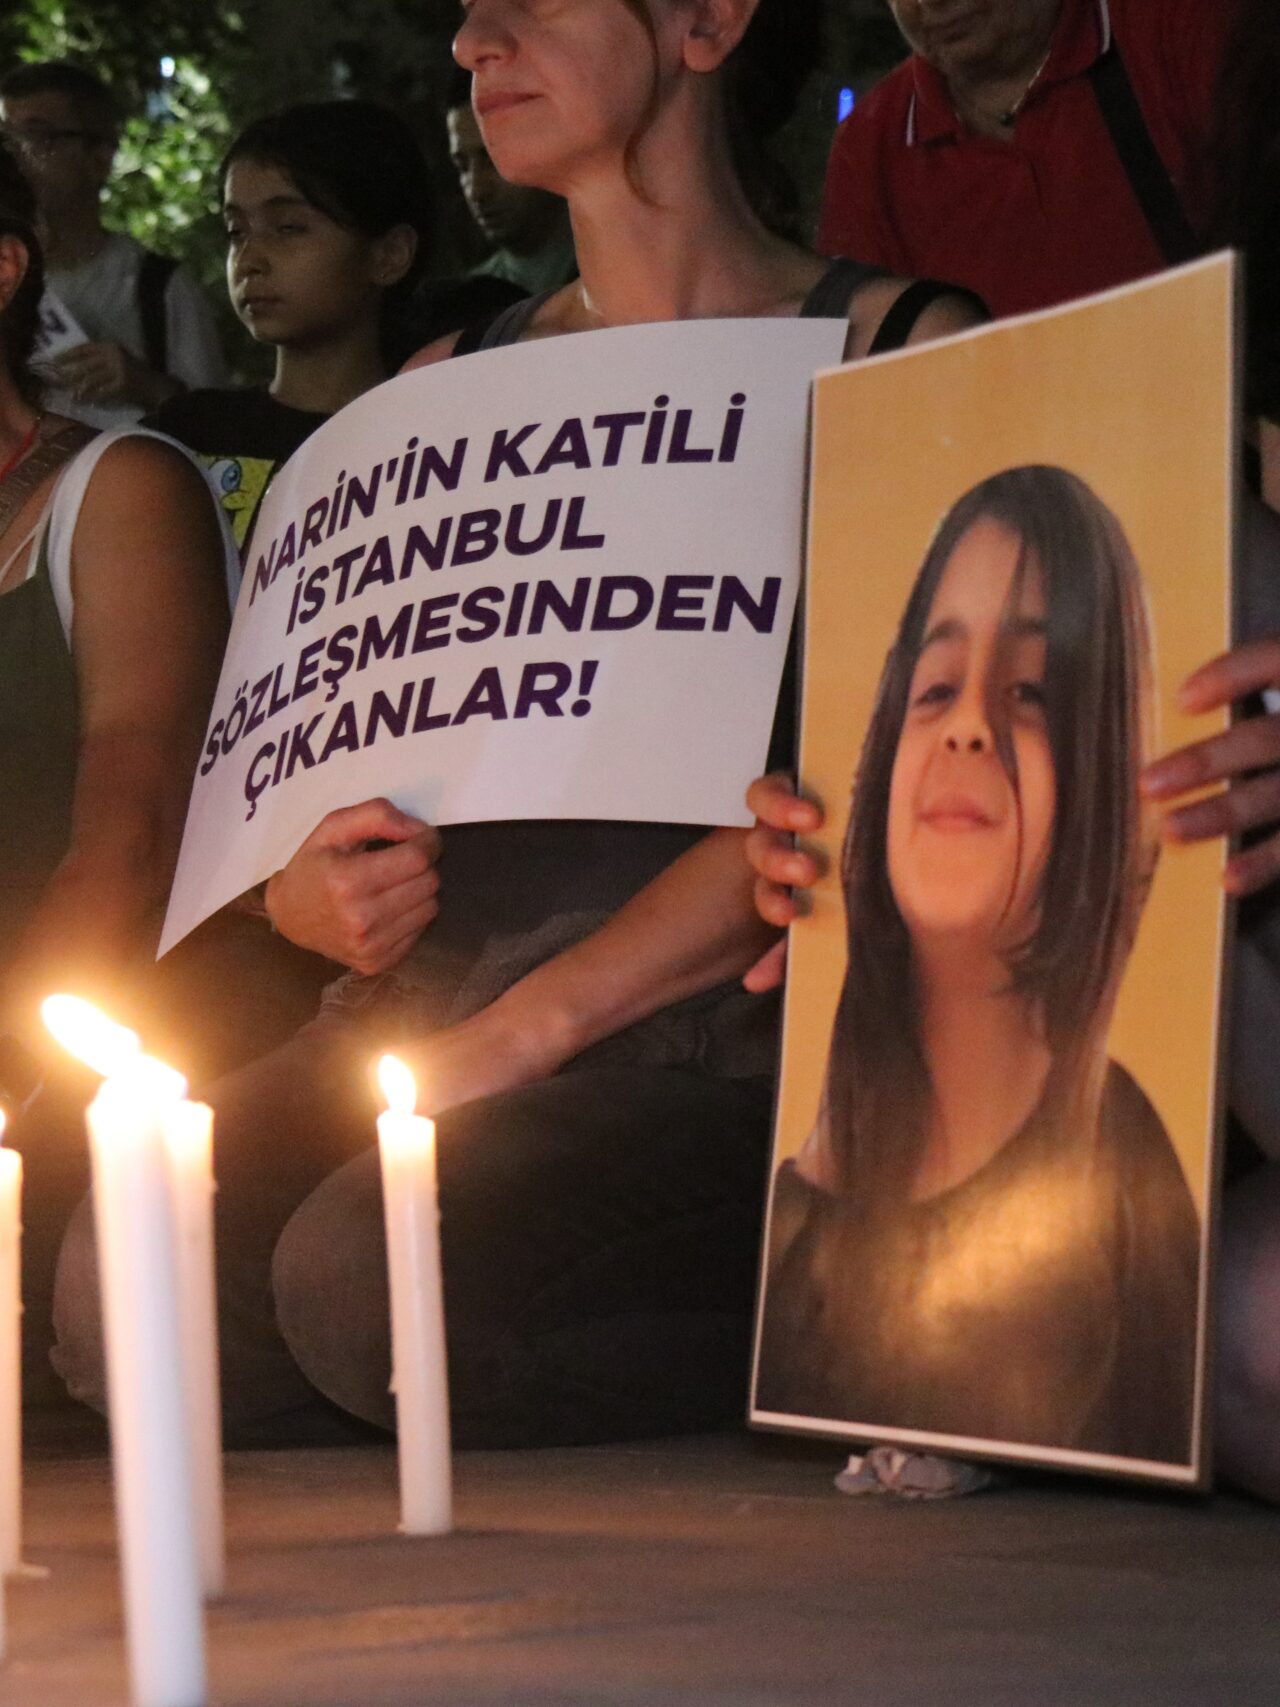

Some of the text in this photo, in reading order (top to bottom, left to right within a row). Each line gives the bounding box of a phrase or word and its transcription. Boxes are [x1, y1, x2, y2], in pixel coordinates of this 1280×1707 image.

[248, 392, 746, 608] NARİN'İN KATİLİ
[286, 496, 606, 637] İSTANBUL
[201, 574, 782, 777] SÖZLEŞMESINDEN
[244, 659, 600, 822] ÇIKANLAR!
